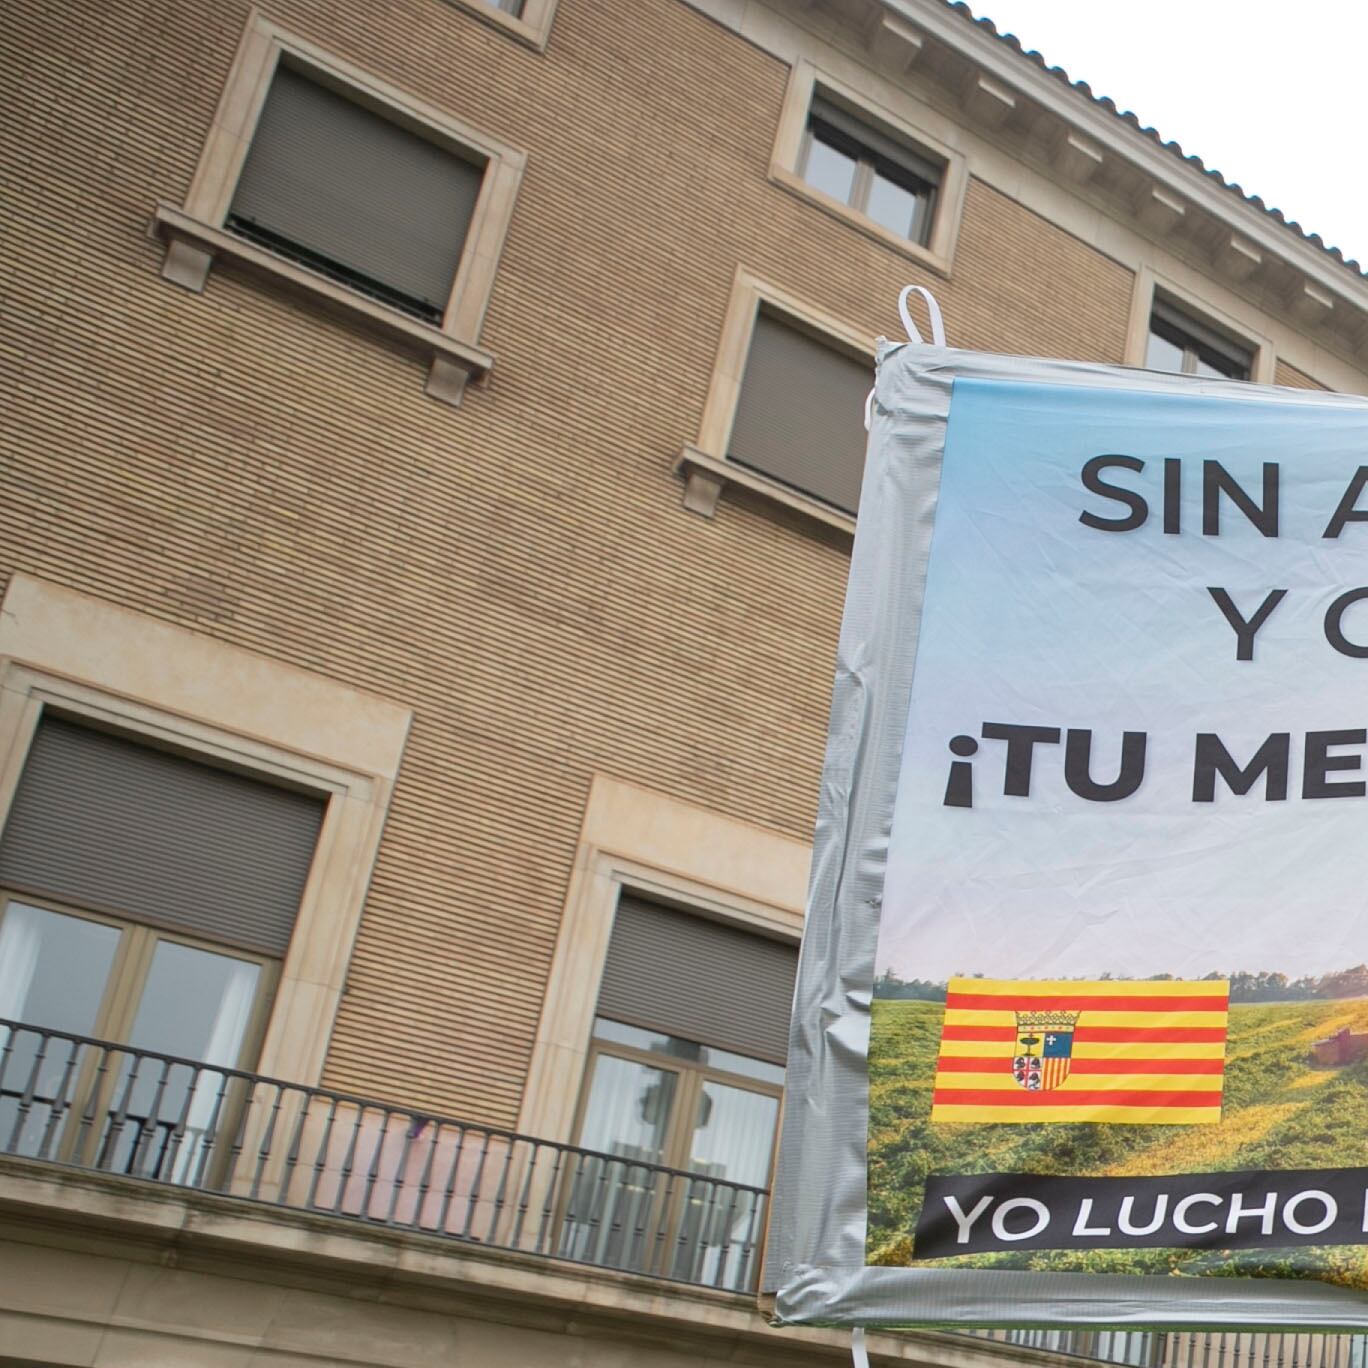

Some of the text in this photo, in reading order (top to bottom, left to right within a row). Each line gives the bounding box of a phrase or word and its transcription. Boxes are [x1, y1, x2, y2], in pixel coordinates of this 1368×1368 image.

[1078, 453, 1280, 538] SIN
[1206, 586, 1289, 662] Y
[942, 722, 1148, 809] ¡TU
[943, 1195, 1052, 1244] YO
[1071, 1189, 1339, 1237] LUCHO
